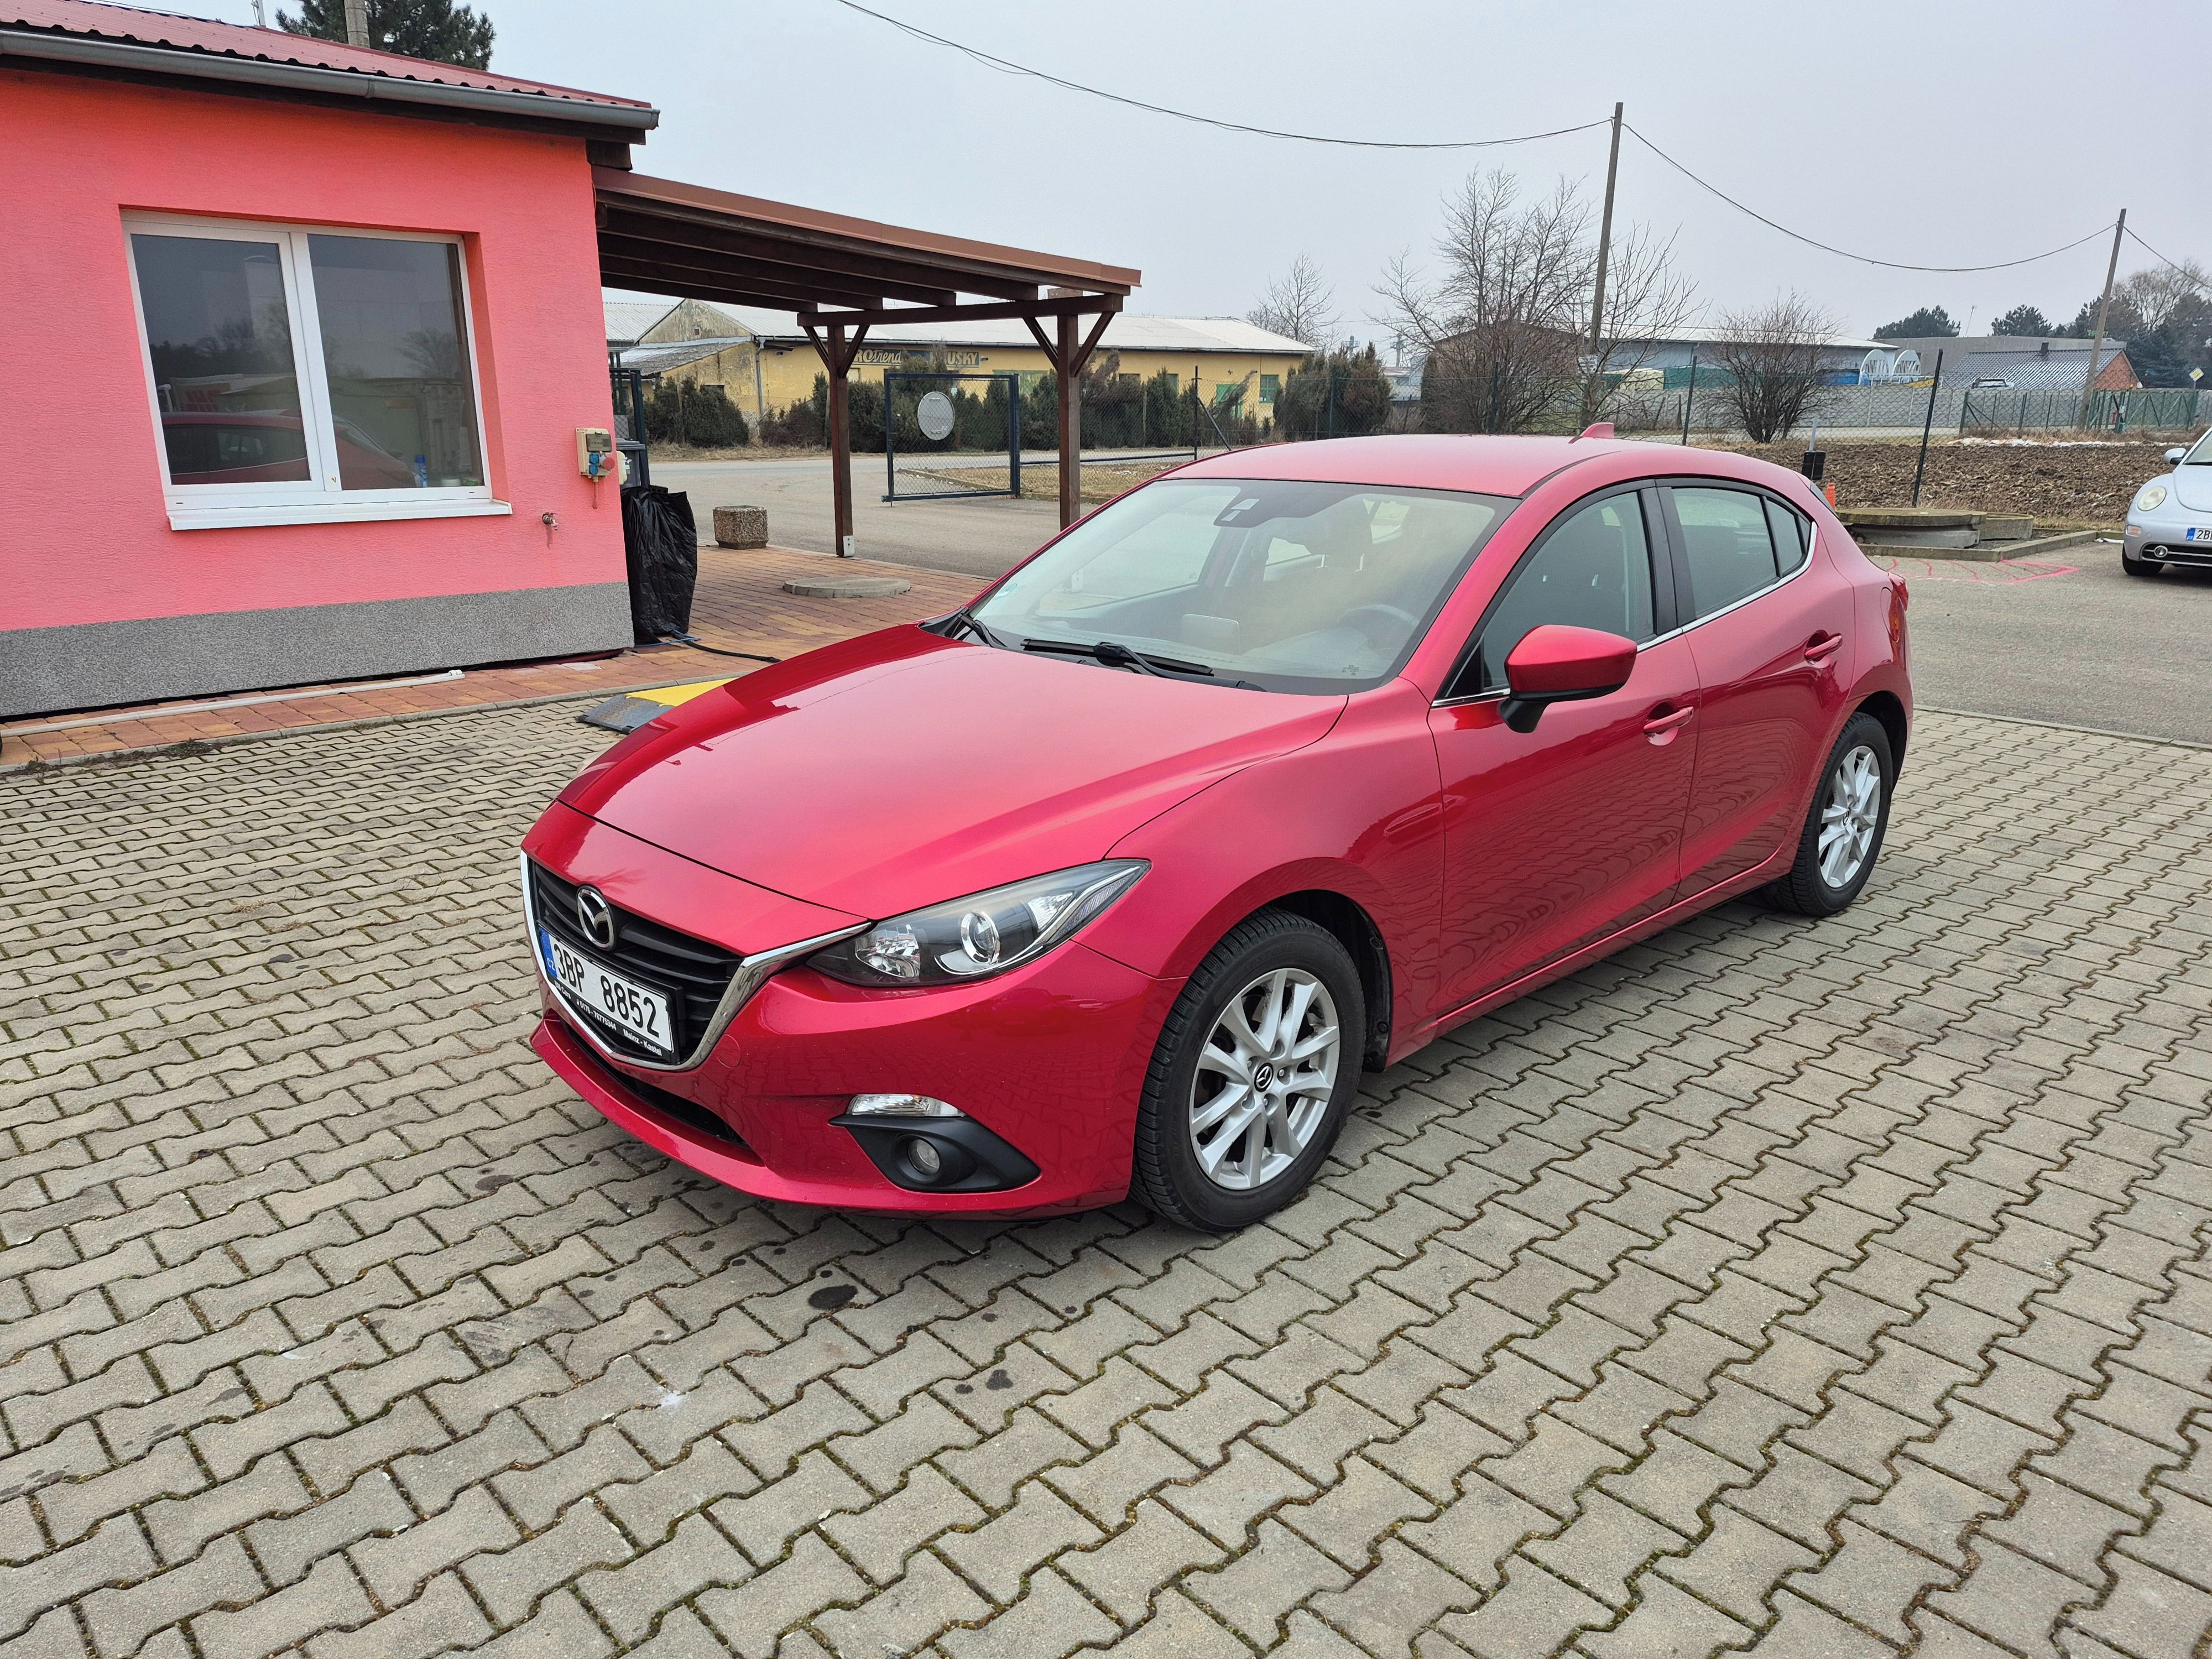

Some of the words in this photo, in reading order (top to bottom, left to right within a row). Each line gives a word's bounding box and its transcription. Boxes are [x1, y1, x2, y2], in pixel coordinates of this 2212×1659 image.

[547, 957, 555, 971] CZ
[554, 943, 585, 993] 3BP
[601, 975, 659, 1039] 8852
[643, 1040, 662, 1056] Kastel
